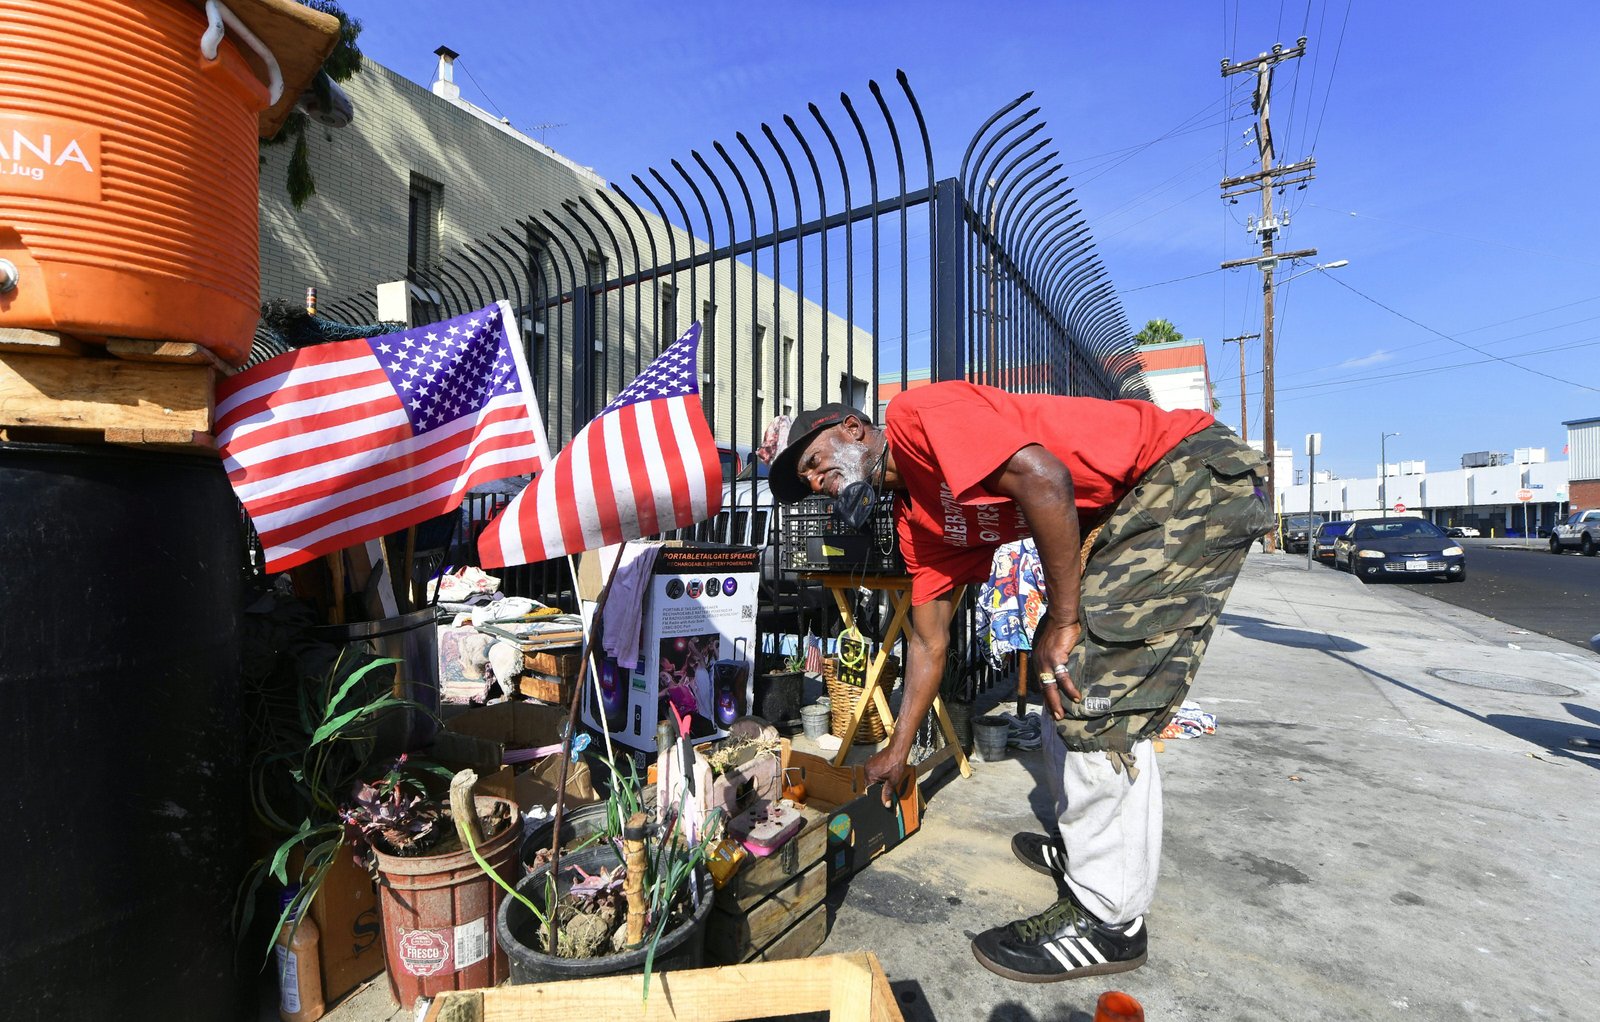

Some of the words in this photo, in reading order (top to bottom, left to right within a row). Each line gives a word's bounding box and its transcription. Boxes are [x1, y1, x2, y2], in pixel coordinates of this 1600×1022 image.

[0, 129, 94, 173] NA
[10, 162, 45, 180] Jug
[407, 947, 439, 958] FRESCO
